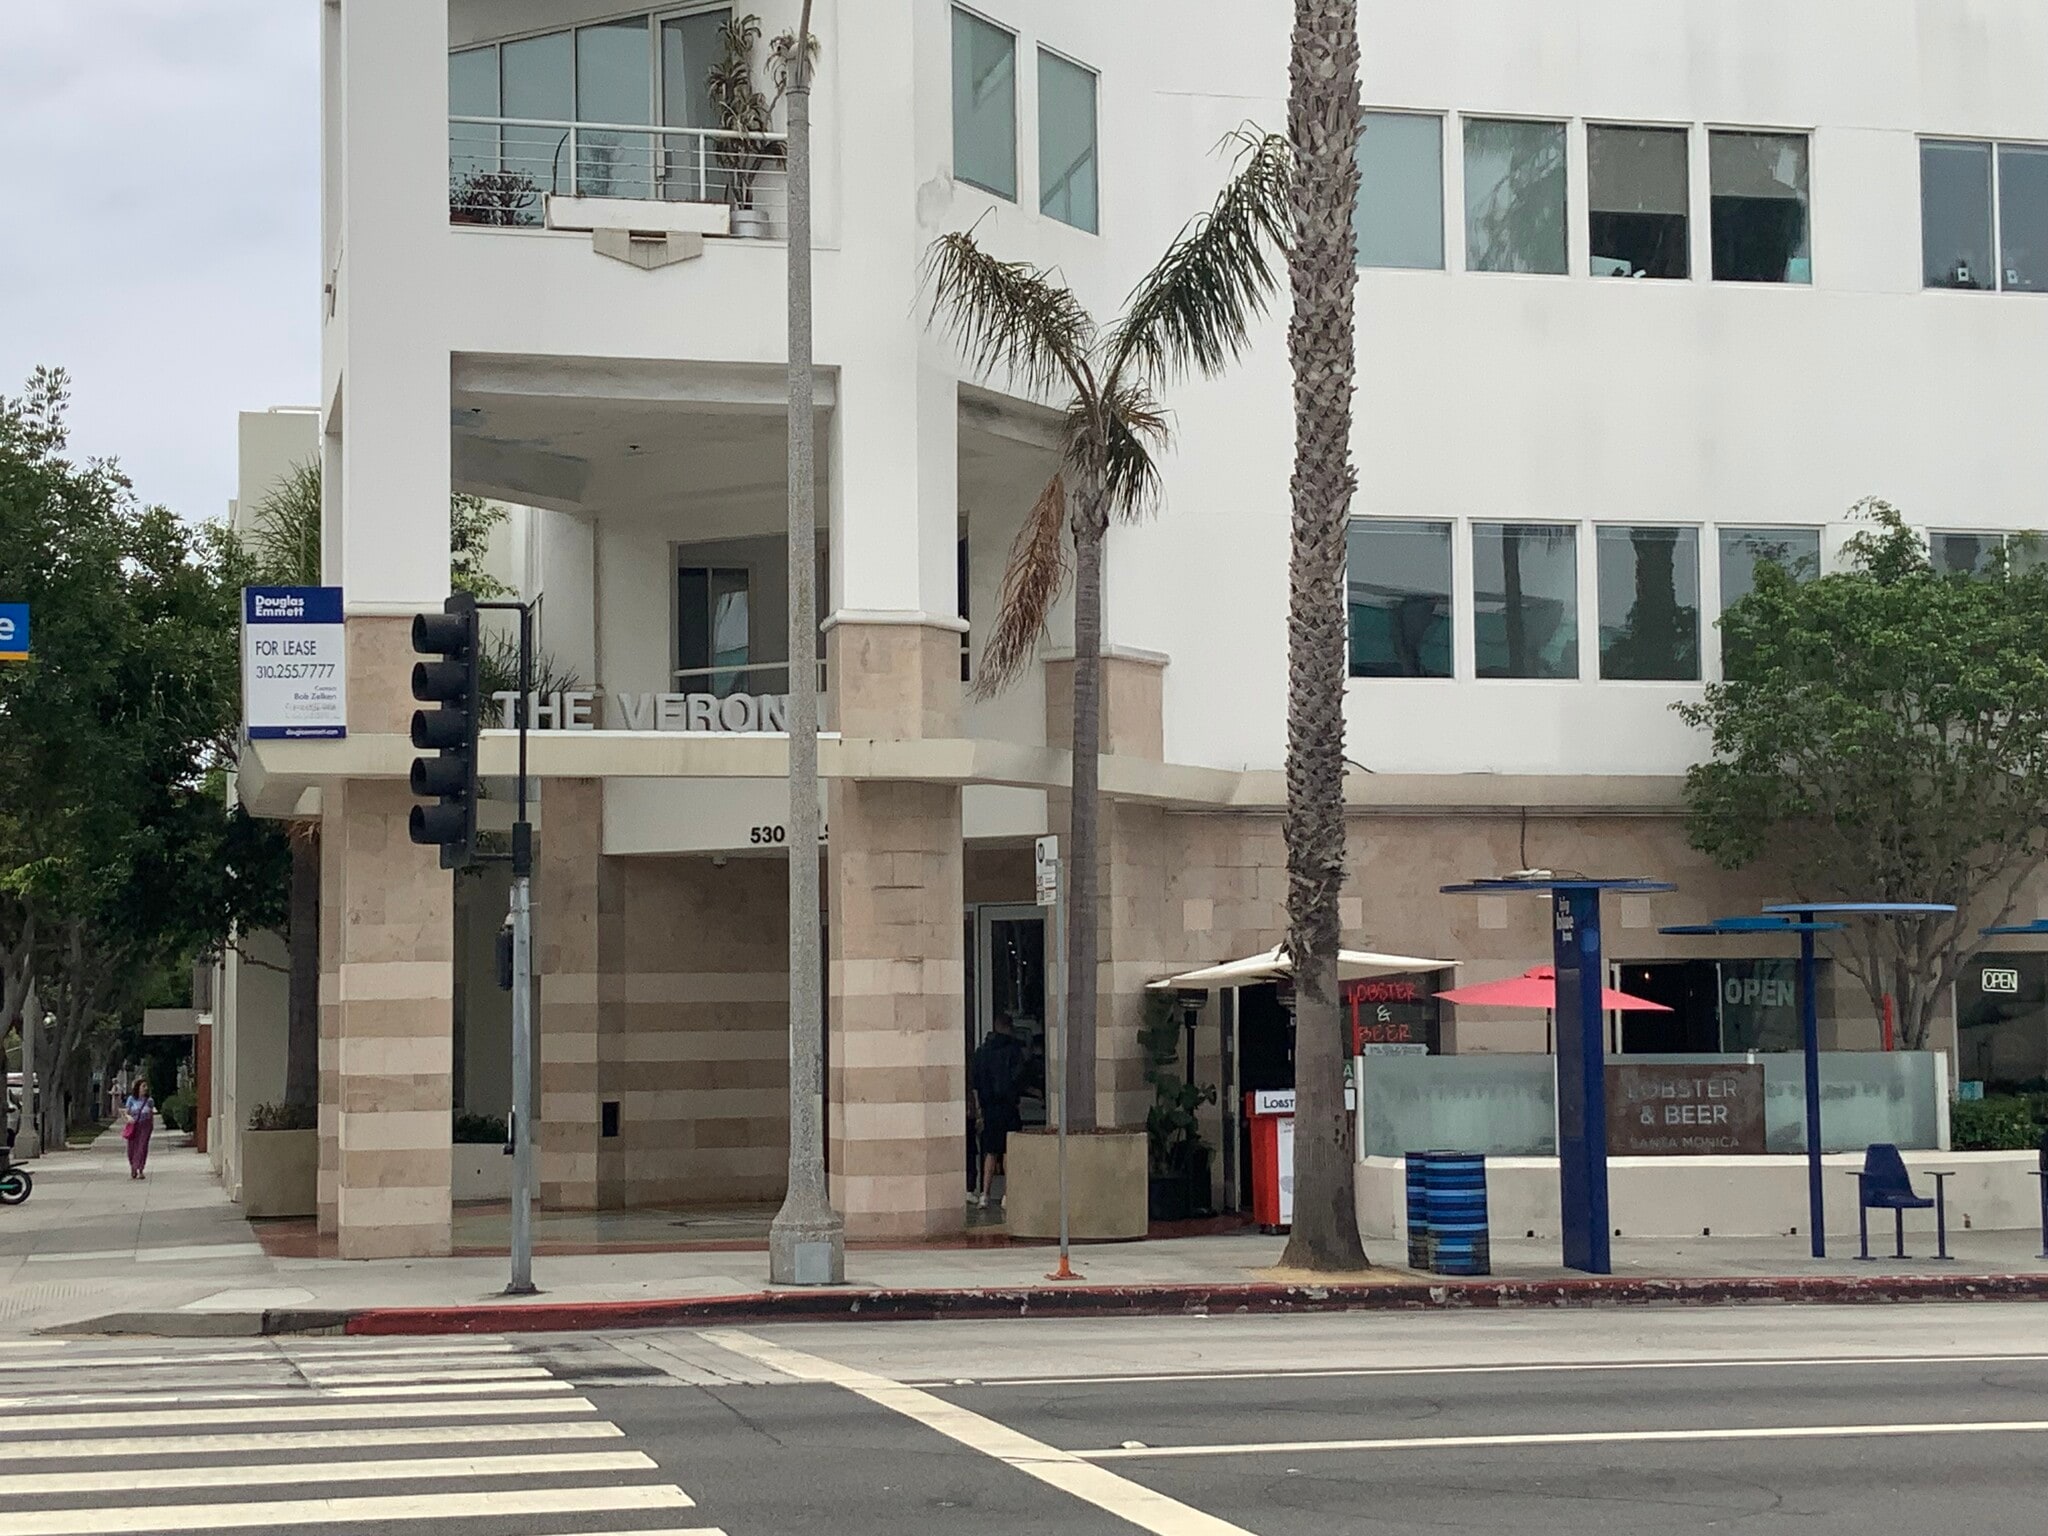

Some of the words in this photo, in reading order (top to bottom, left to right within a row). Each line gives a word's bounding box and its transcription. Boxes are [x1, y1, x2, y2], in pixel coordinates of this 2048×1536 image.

[255, 595, 304, 608] Douglas
[255, 606, 304, 616] Emmett
[256, 641, 278, 655] FOR
[283, 641, 316, 655] LEASE
[491, 690, 594, 731] THE
[617, 692, 827, 732] VERON
[750, 825, 785, 843] 530
[1984, 972, 2016, 989] OPEN
[1725, 978, 1795, 1007] OPEN
[1377, 1004, 1392, 1022] &
[1359, 1024, 1412, 1042] BEER
[1628, 1079, 1738, 1099] LOBSTER
[1263, 1096, 1295, 1109] LOBST
[1640, 1104, 1655, 1124] &
[1665, 1104, 1728, 1124] BEER
